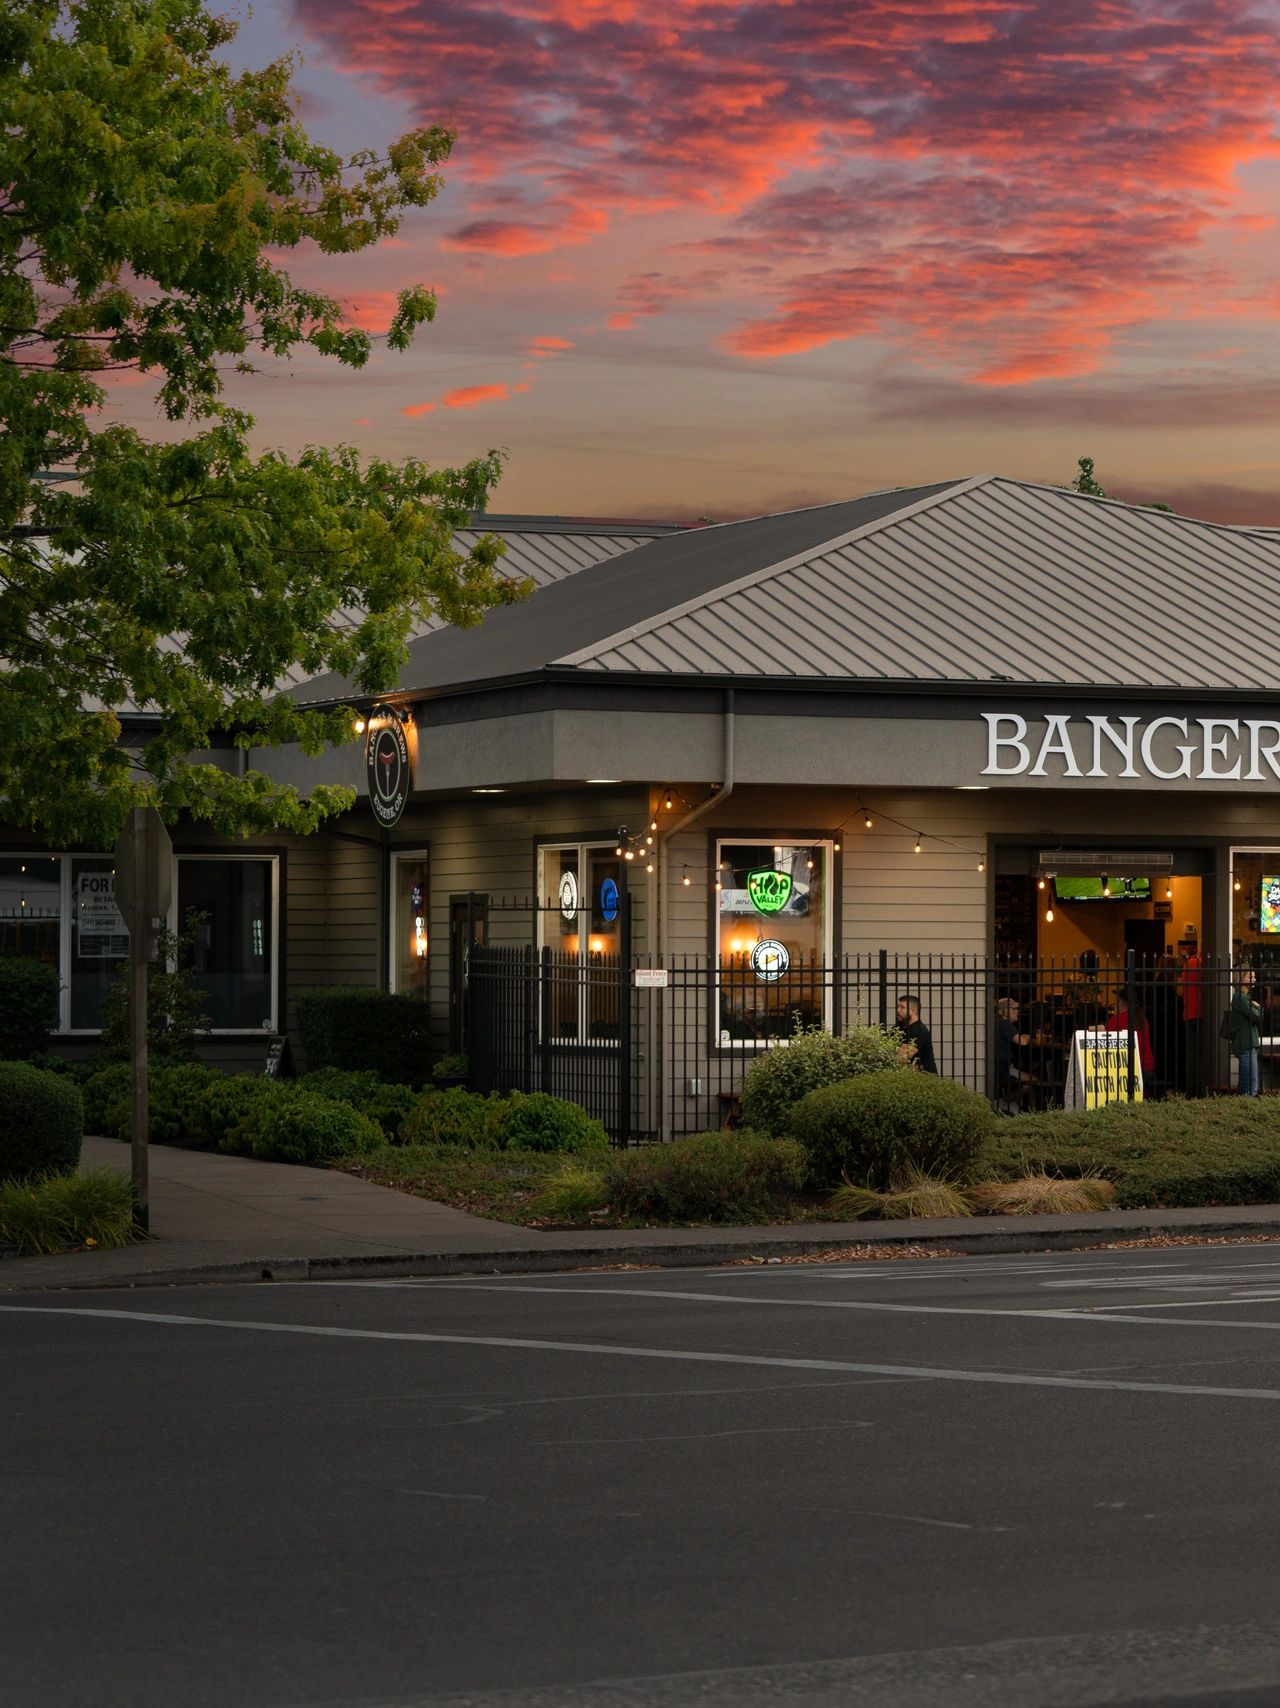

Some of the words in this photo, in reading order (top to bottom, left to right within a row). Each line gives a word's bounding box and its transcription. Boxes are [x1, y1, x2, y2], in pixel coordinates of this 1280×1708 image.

[393, 793, 404, 811] OR
[82, 878, 109, 893] FOR
[756, 895, 784, 904] VALLEY
[1117, 1075, 1141, 1093] YOR
